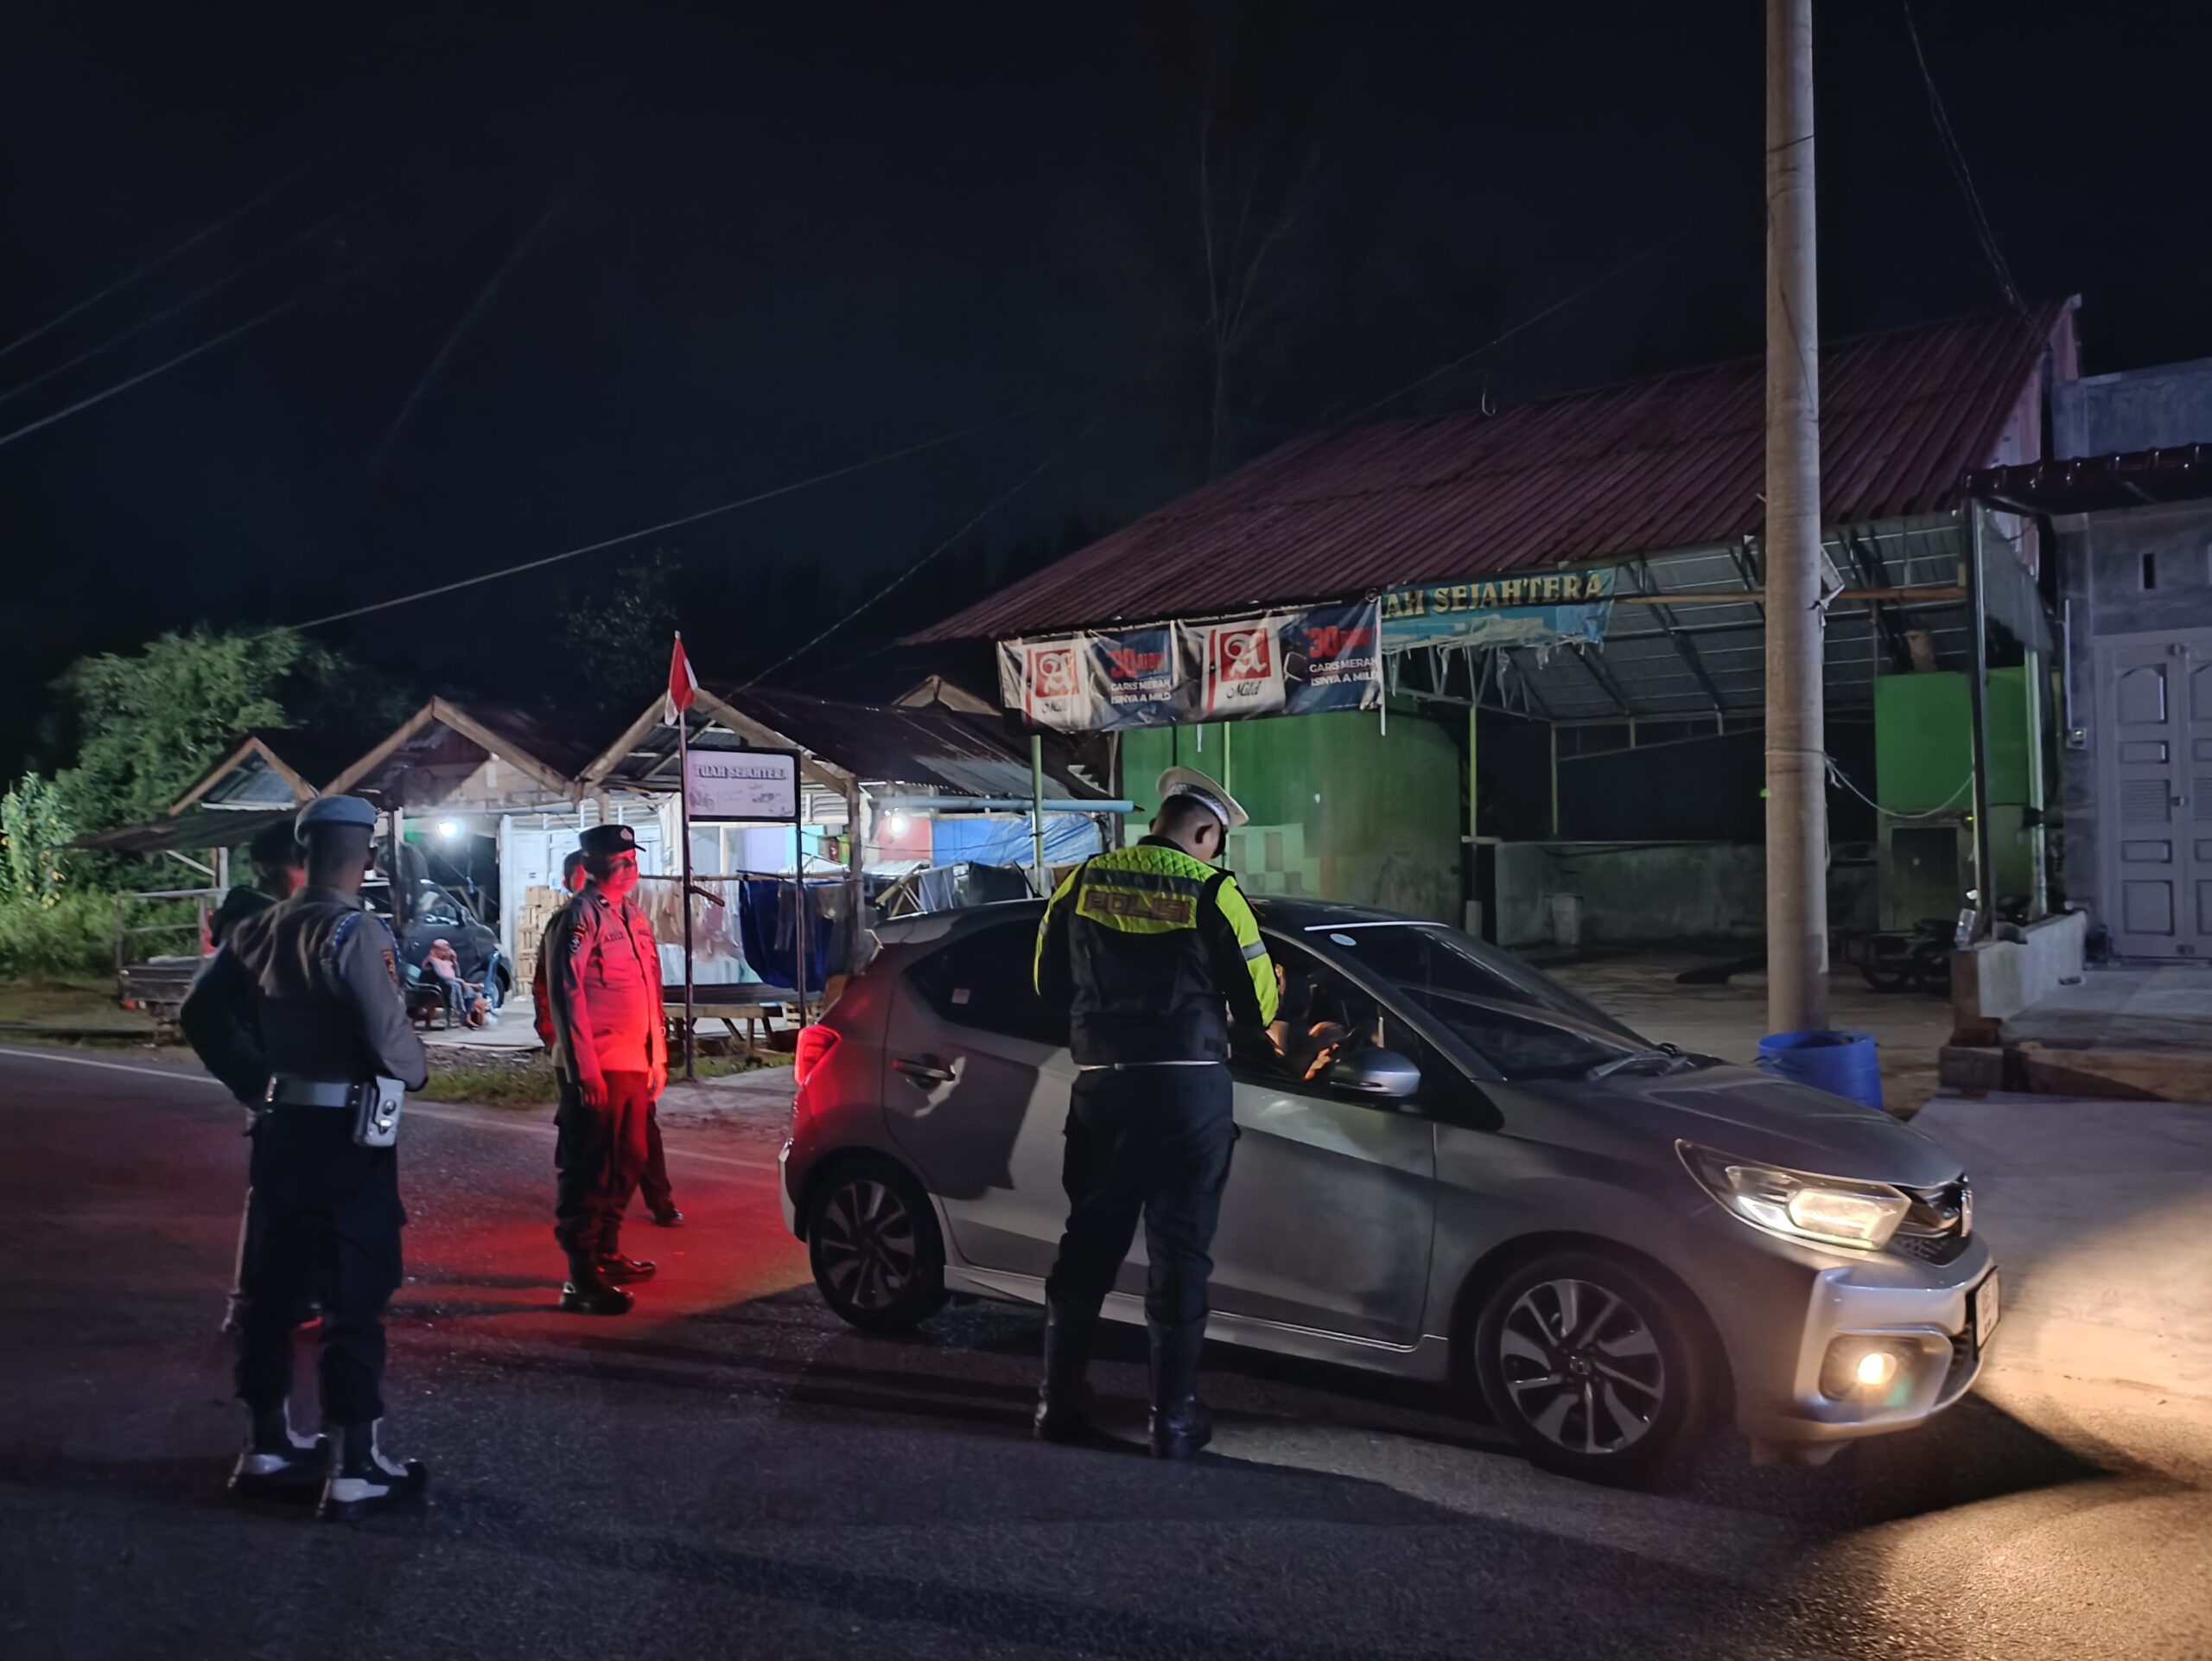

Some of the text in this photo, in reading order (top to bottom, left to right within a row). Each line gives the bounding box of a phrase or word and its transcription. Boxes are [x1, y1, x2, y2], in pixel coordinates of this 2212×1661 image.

[1433, 573, 1605, 614] SEJAHTERA
[1342, 674, 1351, 683] A
[1139, 693, 1147, 702] A
[1227, 681, 1261, 698] Mild
[1084, 890, 1191, 923] POLISI
